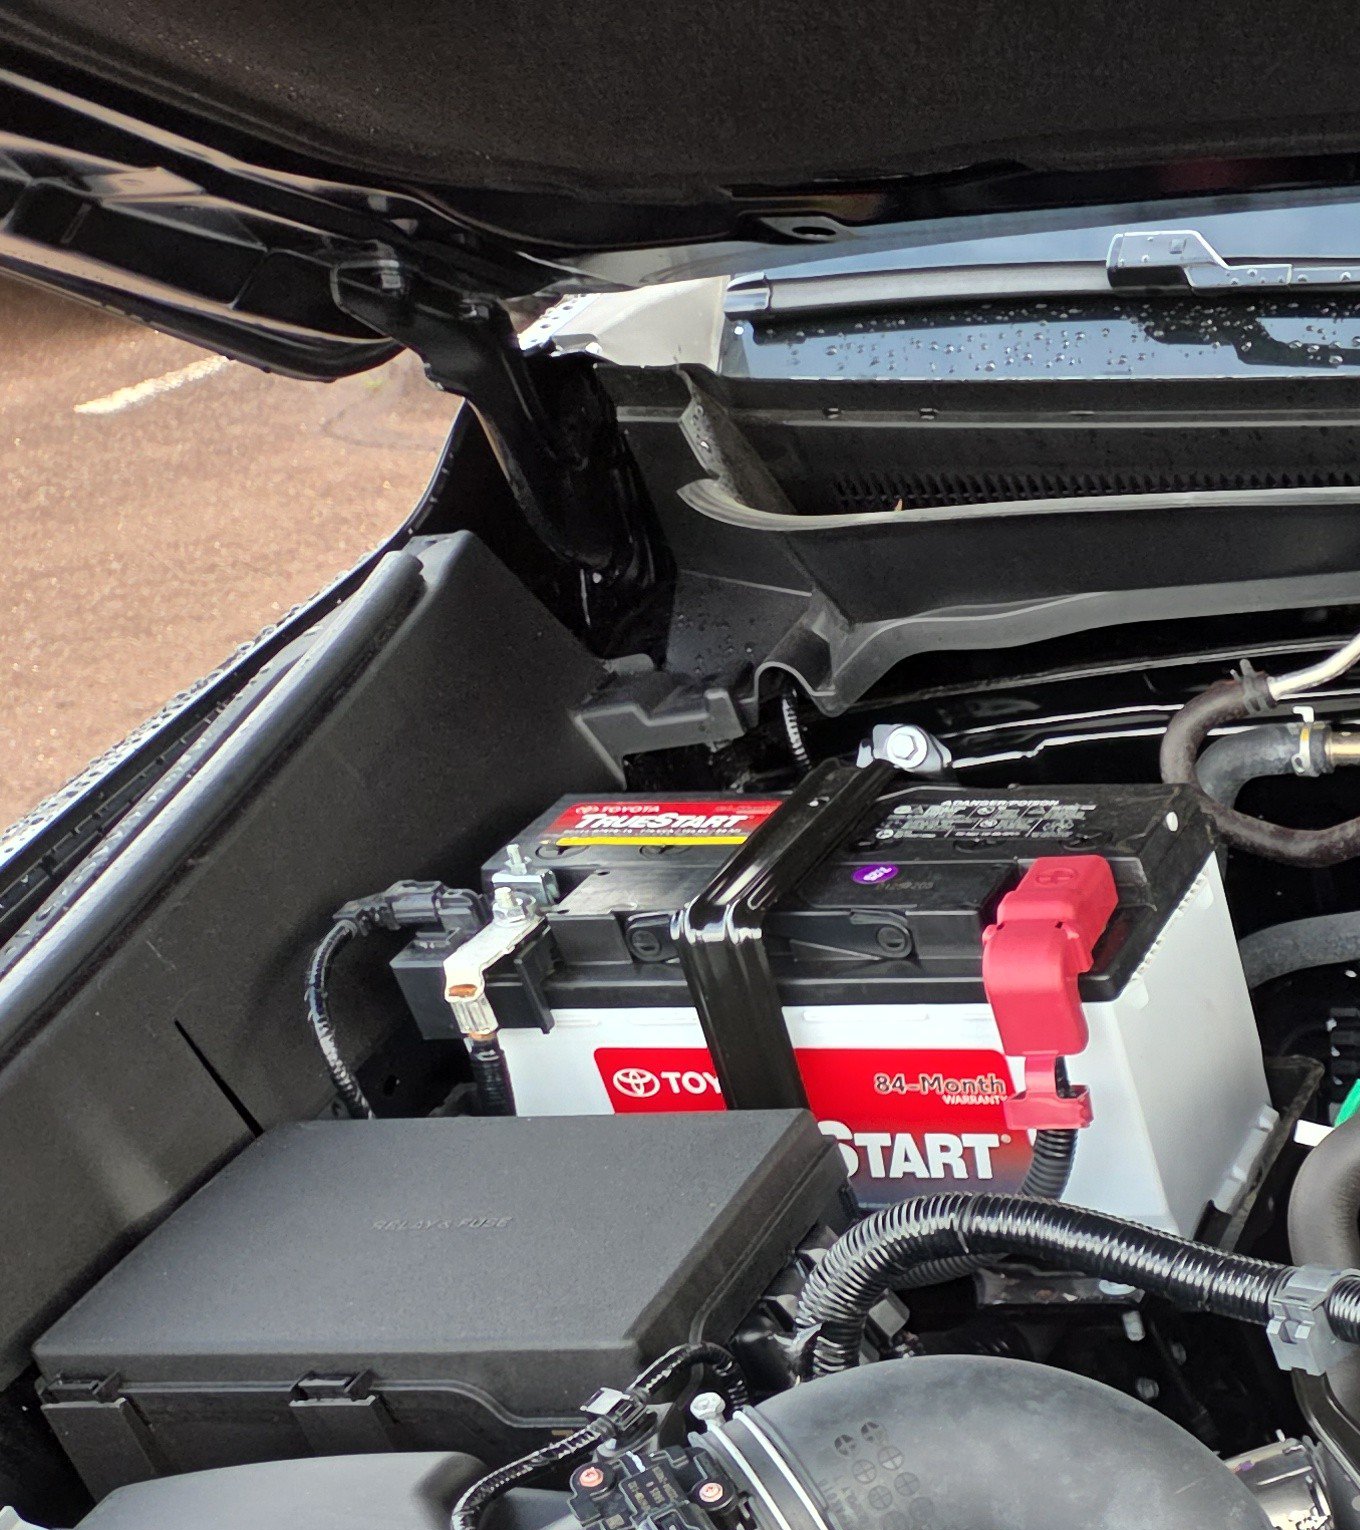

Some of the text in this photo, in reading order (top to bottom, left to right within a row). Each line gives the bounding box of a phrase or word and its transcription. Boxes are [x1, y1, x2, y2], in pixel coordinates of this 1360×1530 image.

[601, 805, 660, 814] TOYOTA
[660, 1071, 722, 1095] TOY
[873, 1071, 1006, 1095] 84-Month
[817, 1119, 1000, 1180] START
